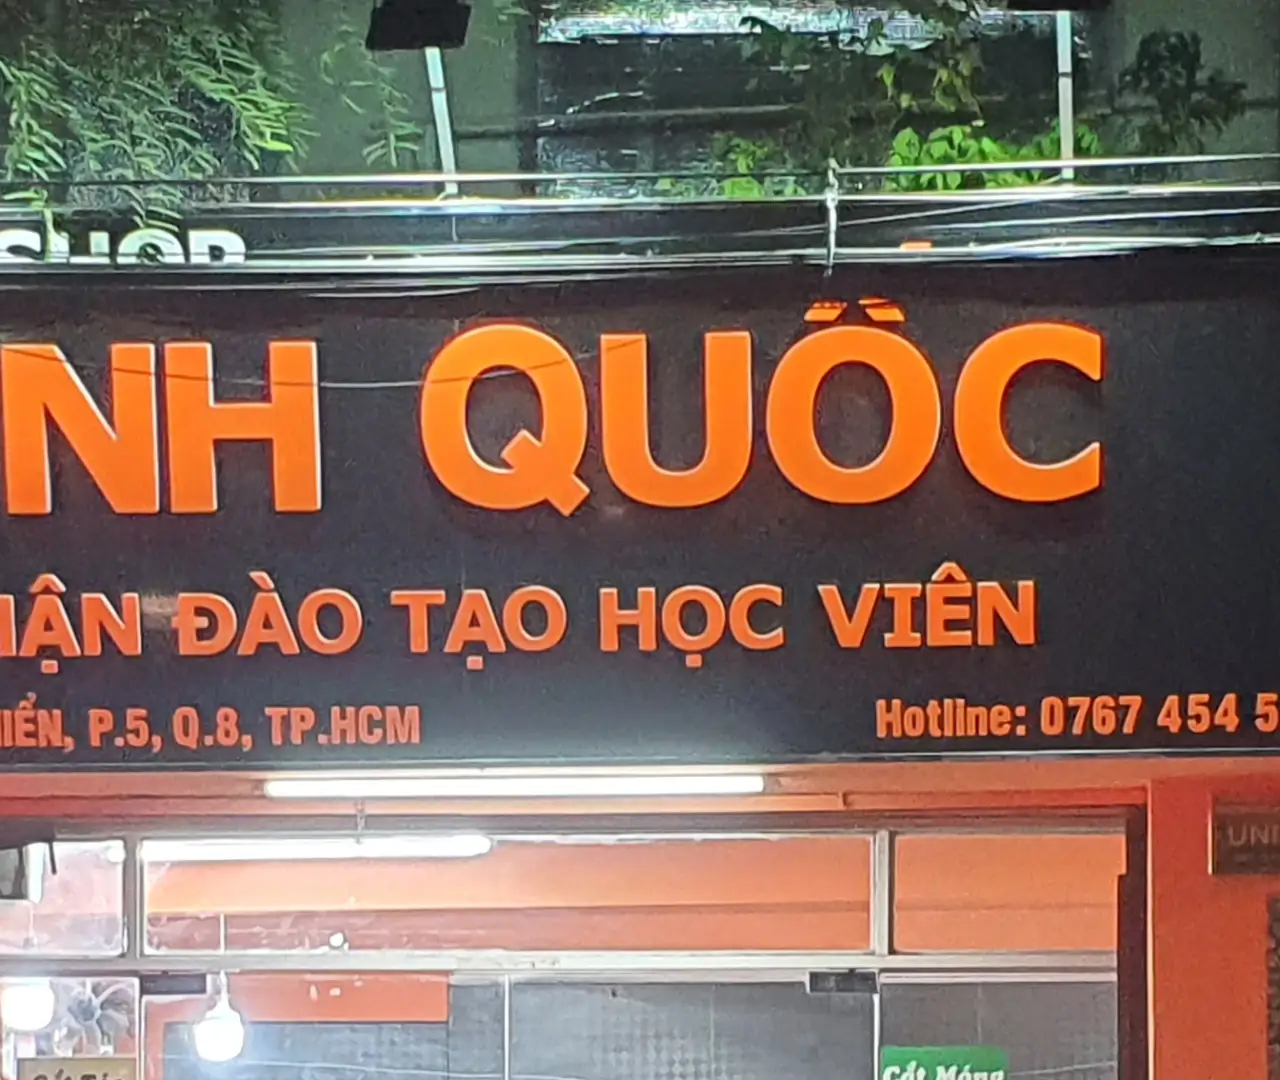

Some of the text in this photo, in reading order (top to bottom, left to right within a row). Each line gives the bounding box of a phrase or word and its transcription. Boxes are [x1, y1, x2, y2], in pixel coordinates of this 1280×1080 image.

[172, 571, 362, 656] ĐÀO
[392, 588, 567, 669] TẠO
[600, 584, 784, 668] HỌC
[819, 561, 1036, 649] VIÊN
[89, 708, 163, 750] P.5,
[173, 708, 253, 749] Q.8,
[267, 706, 420, 743] TP.HCM
[876, 698, 1027, 738] Hotline:
[1040, 695, 1143, 736] 0767
[1157, 692, 1240, 734] 454
